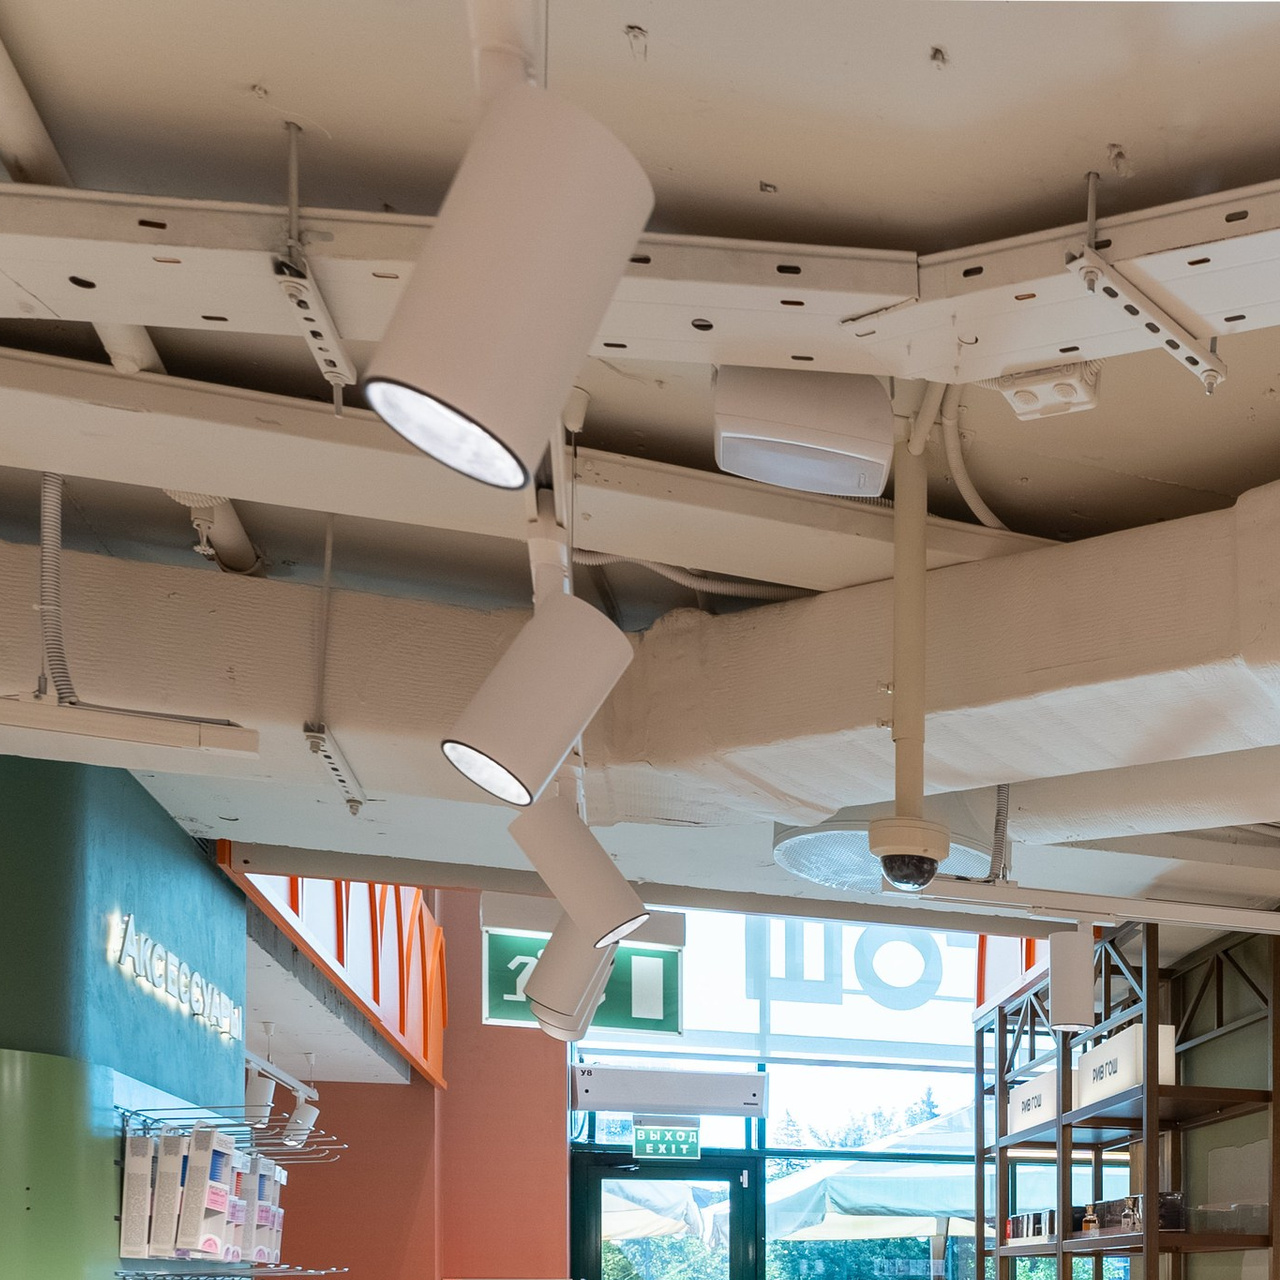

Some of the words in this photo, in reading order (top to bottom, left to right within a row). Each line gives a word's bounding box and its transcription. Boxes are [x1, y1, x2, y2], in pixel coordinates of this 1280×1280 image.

[1092, 1065, 1105, 1083] РИВ
[636, 1130, 698, 1143] ВЫХОД
[645, 1144, 689, 1154] EXIT
